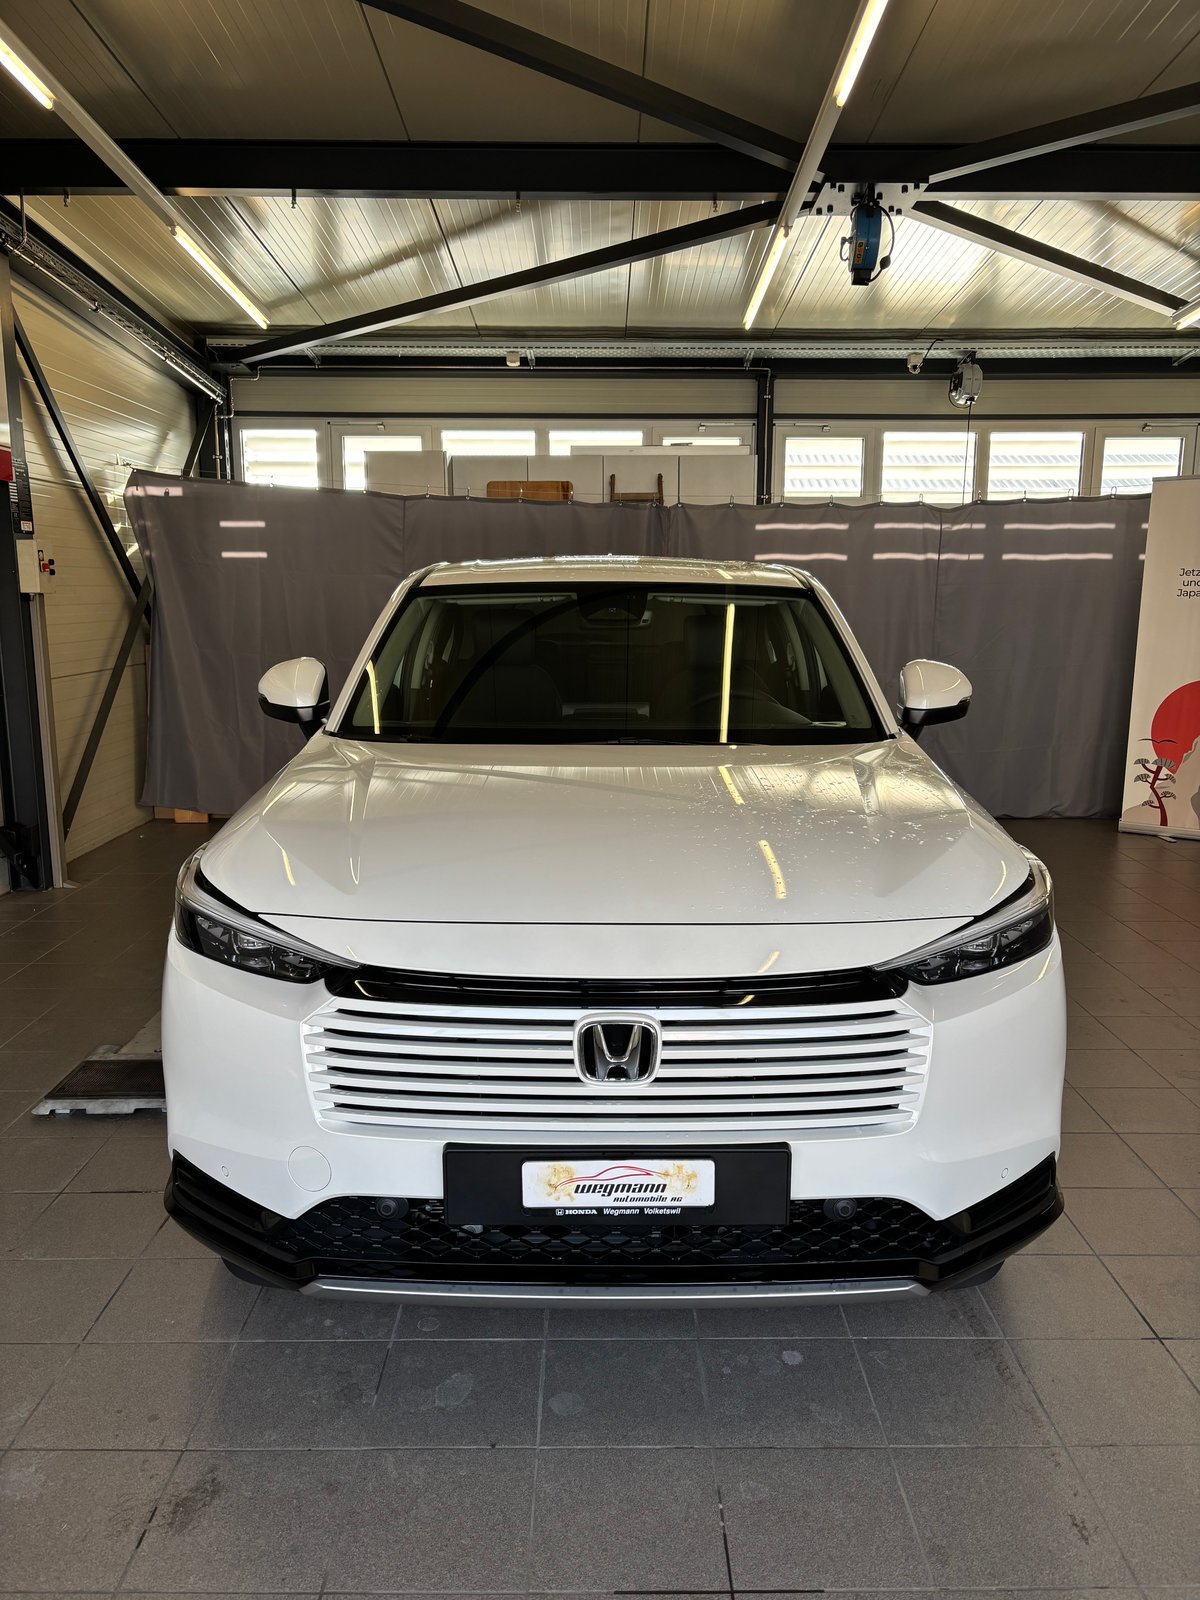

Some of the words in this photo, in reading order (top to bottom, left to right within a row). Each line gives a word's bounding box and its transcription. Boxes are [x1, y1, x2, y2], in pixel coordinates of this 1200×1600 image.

[574, 1183, 667, 1197] wegmann
[603, 1207, 640, 1216] Wegmann
[644, 1207, 681, 1215] Volketswil
